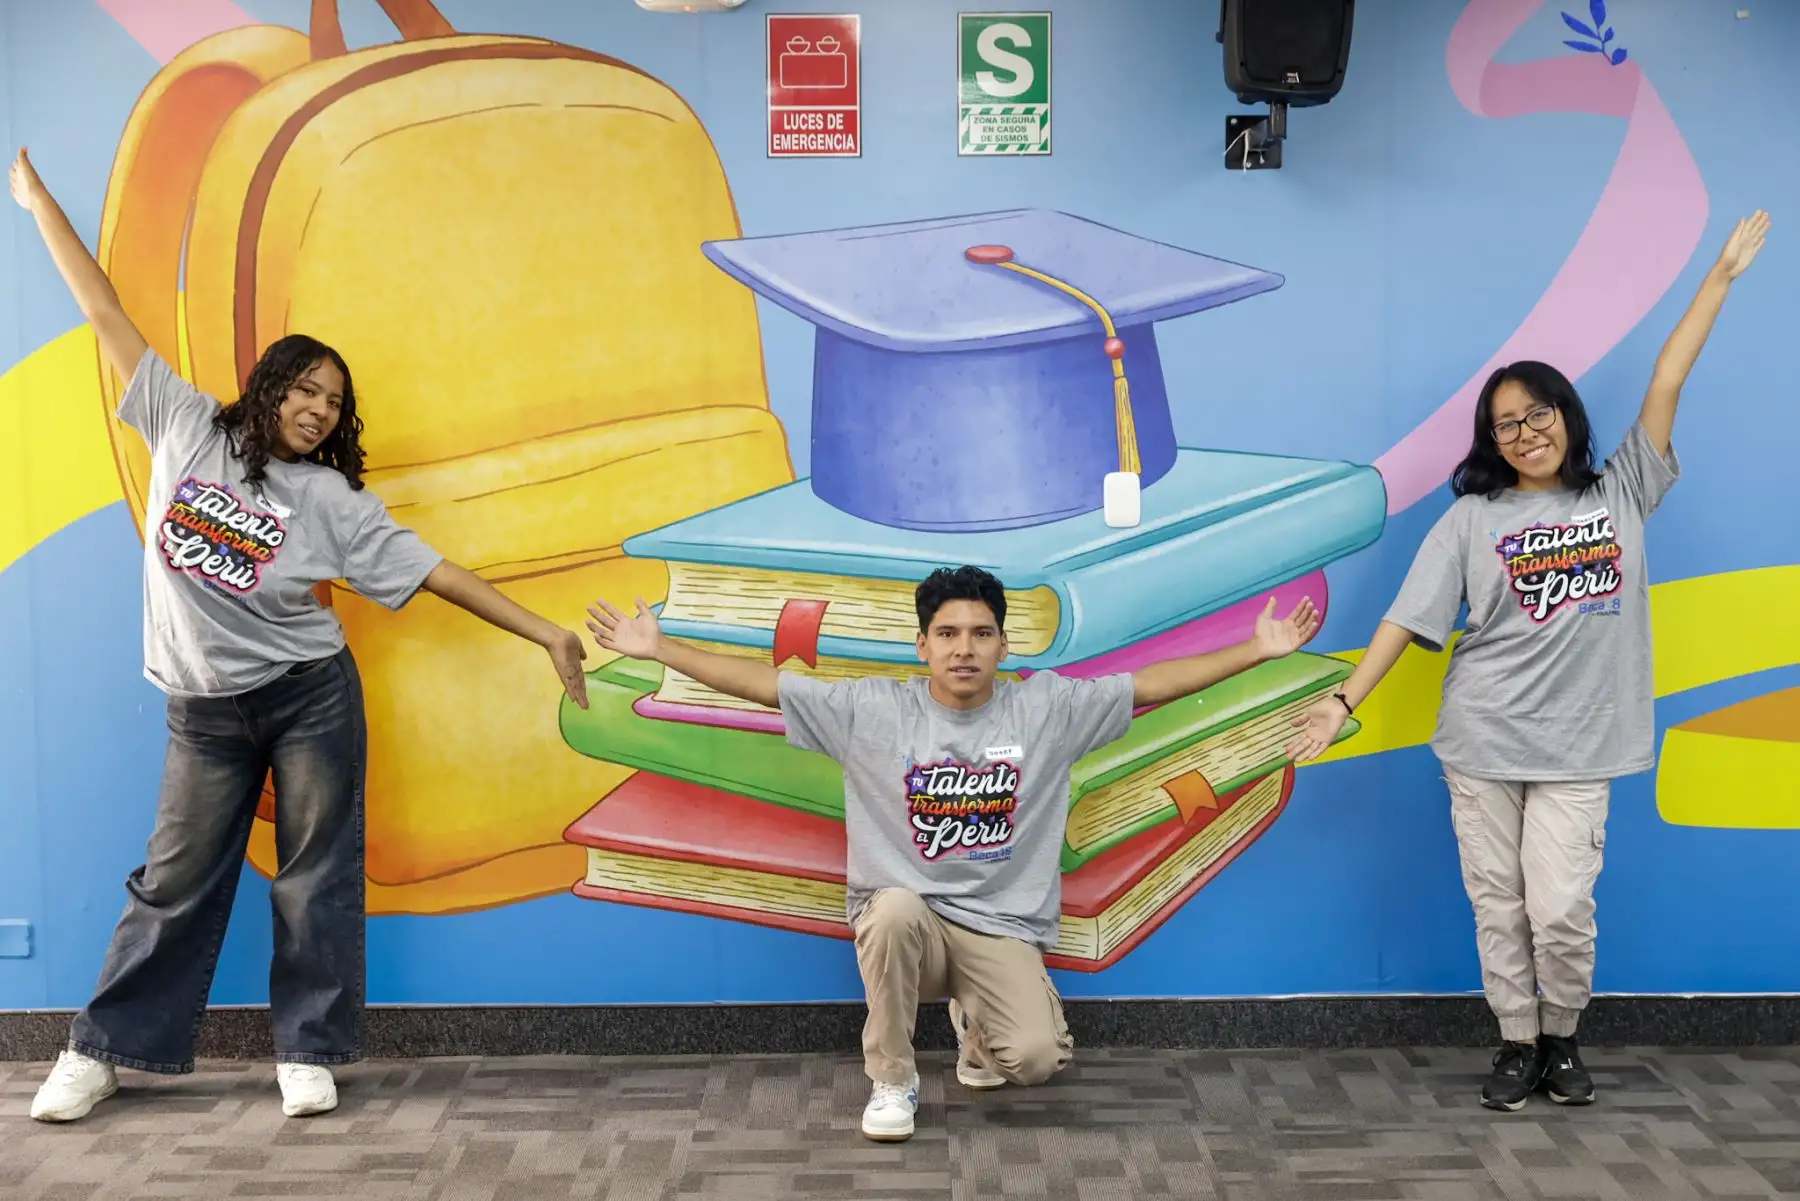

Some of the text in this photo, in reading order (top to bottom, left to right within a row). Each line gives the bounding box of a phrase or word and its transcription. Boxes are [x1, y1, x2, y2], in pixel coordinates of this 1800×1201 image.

[975, 22, 1035, 97] S
[783, 113, 844, 130] LUCES DE
[973, 116, 1036, 124] ZONA SEGURA
[773, 133, 855, 151] EMERGENCIA
[1504, 543, 1517, 552] TU
[1514, 565, 1620, 620] EL Perú
[912, 777, 923, 787] TU
[912, 814, 1013, 858] EL Perú
